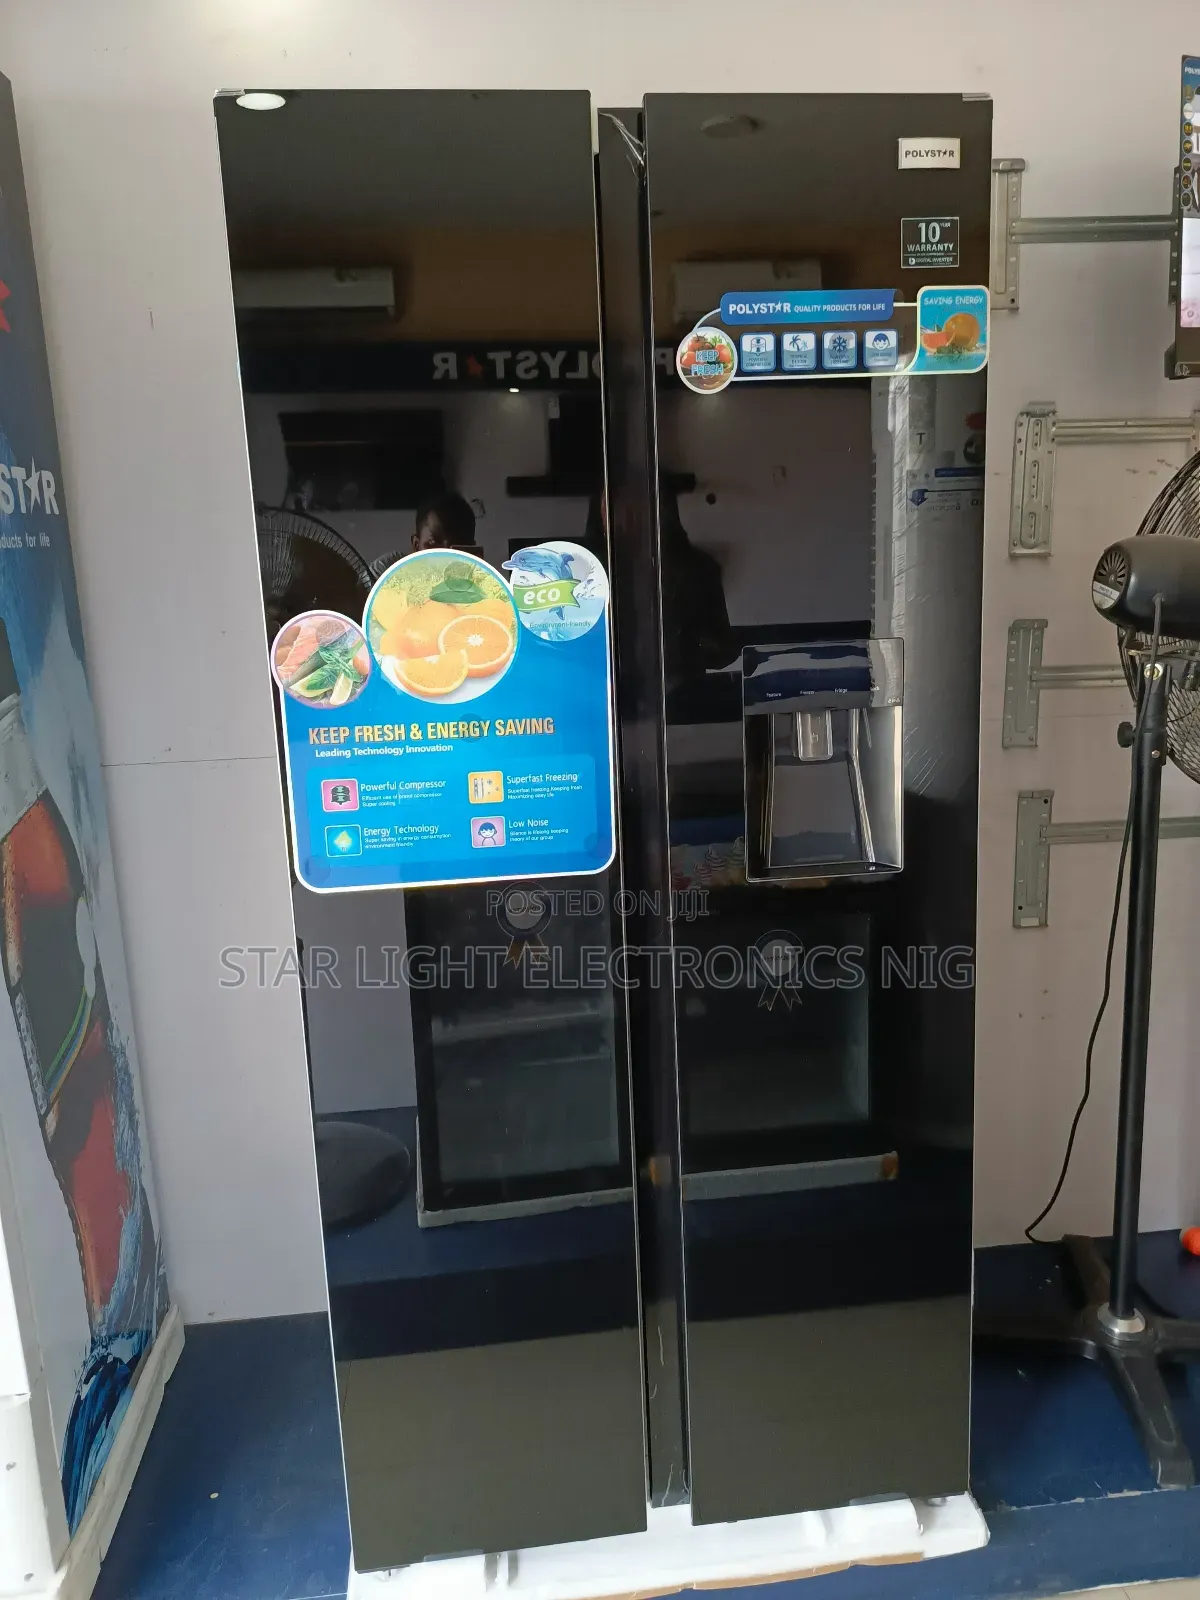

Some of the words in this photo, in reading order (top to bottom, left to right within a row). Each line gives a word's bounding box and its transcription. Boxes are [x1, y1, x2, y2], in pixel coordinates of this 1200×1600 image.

[918, 222, 940, 243] 10
[907, 243, 953, 252] WARRANTY
[923, 296, 953, 305] SAVING
[955, 295, 984, 305] ENERGY
[794, 304, 821, 313] QUALITY
[822, 303, 857, 312] PRODUCTS
[858, 303, 872, 311] FOR
[872, 303, 886, 311] LIFE
[695, 350, 719, 362] KEEP
[691, 363, 724, 376] FRESH
[0, 533, 22, 548] ducts
[25, 532, 36, 547] for
[523, 588, 561, 605] eco
[308, 726, 350, 745] KEEP
[354, 723, 407, 743] FRESH
[410, 723, 423, 740] &
[427, 720, 491, 739] ENERGY
[495, 717, 555, 736] SAVING
[315, 748, 351, 758] Leading
[352, 746, 404, 756] Technology
[406, 743, 454, 753] Innovation
[506, 773, 543, 785] Superfast
[545, 772, 578, 783] Freezing
[360, 781, 397, 792] Powerful
[399, 780, 446, 791] Compressor
[364, 827, 391, 837] Energy
[394, 824, 439, 834] Technology
[508, 820, 525, 829] Low
[527, 819, 549, 828] Noise
